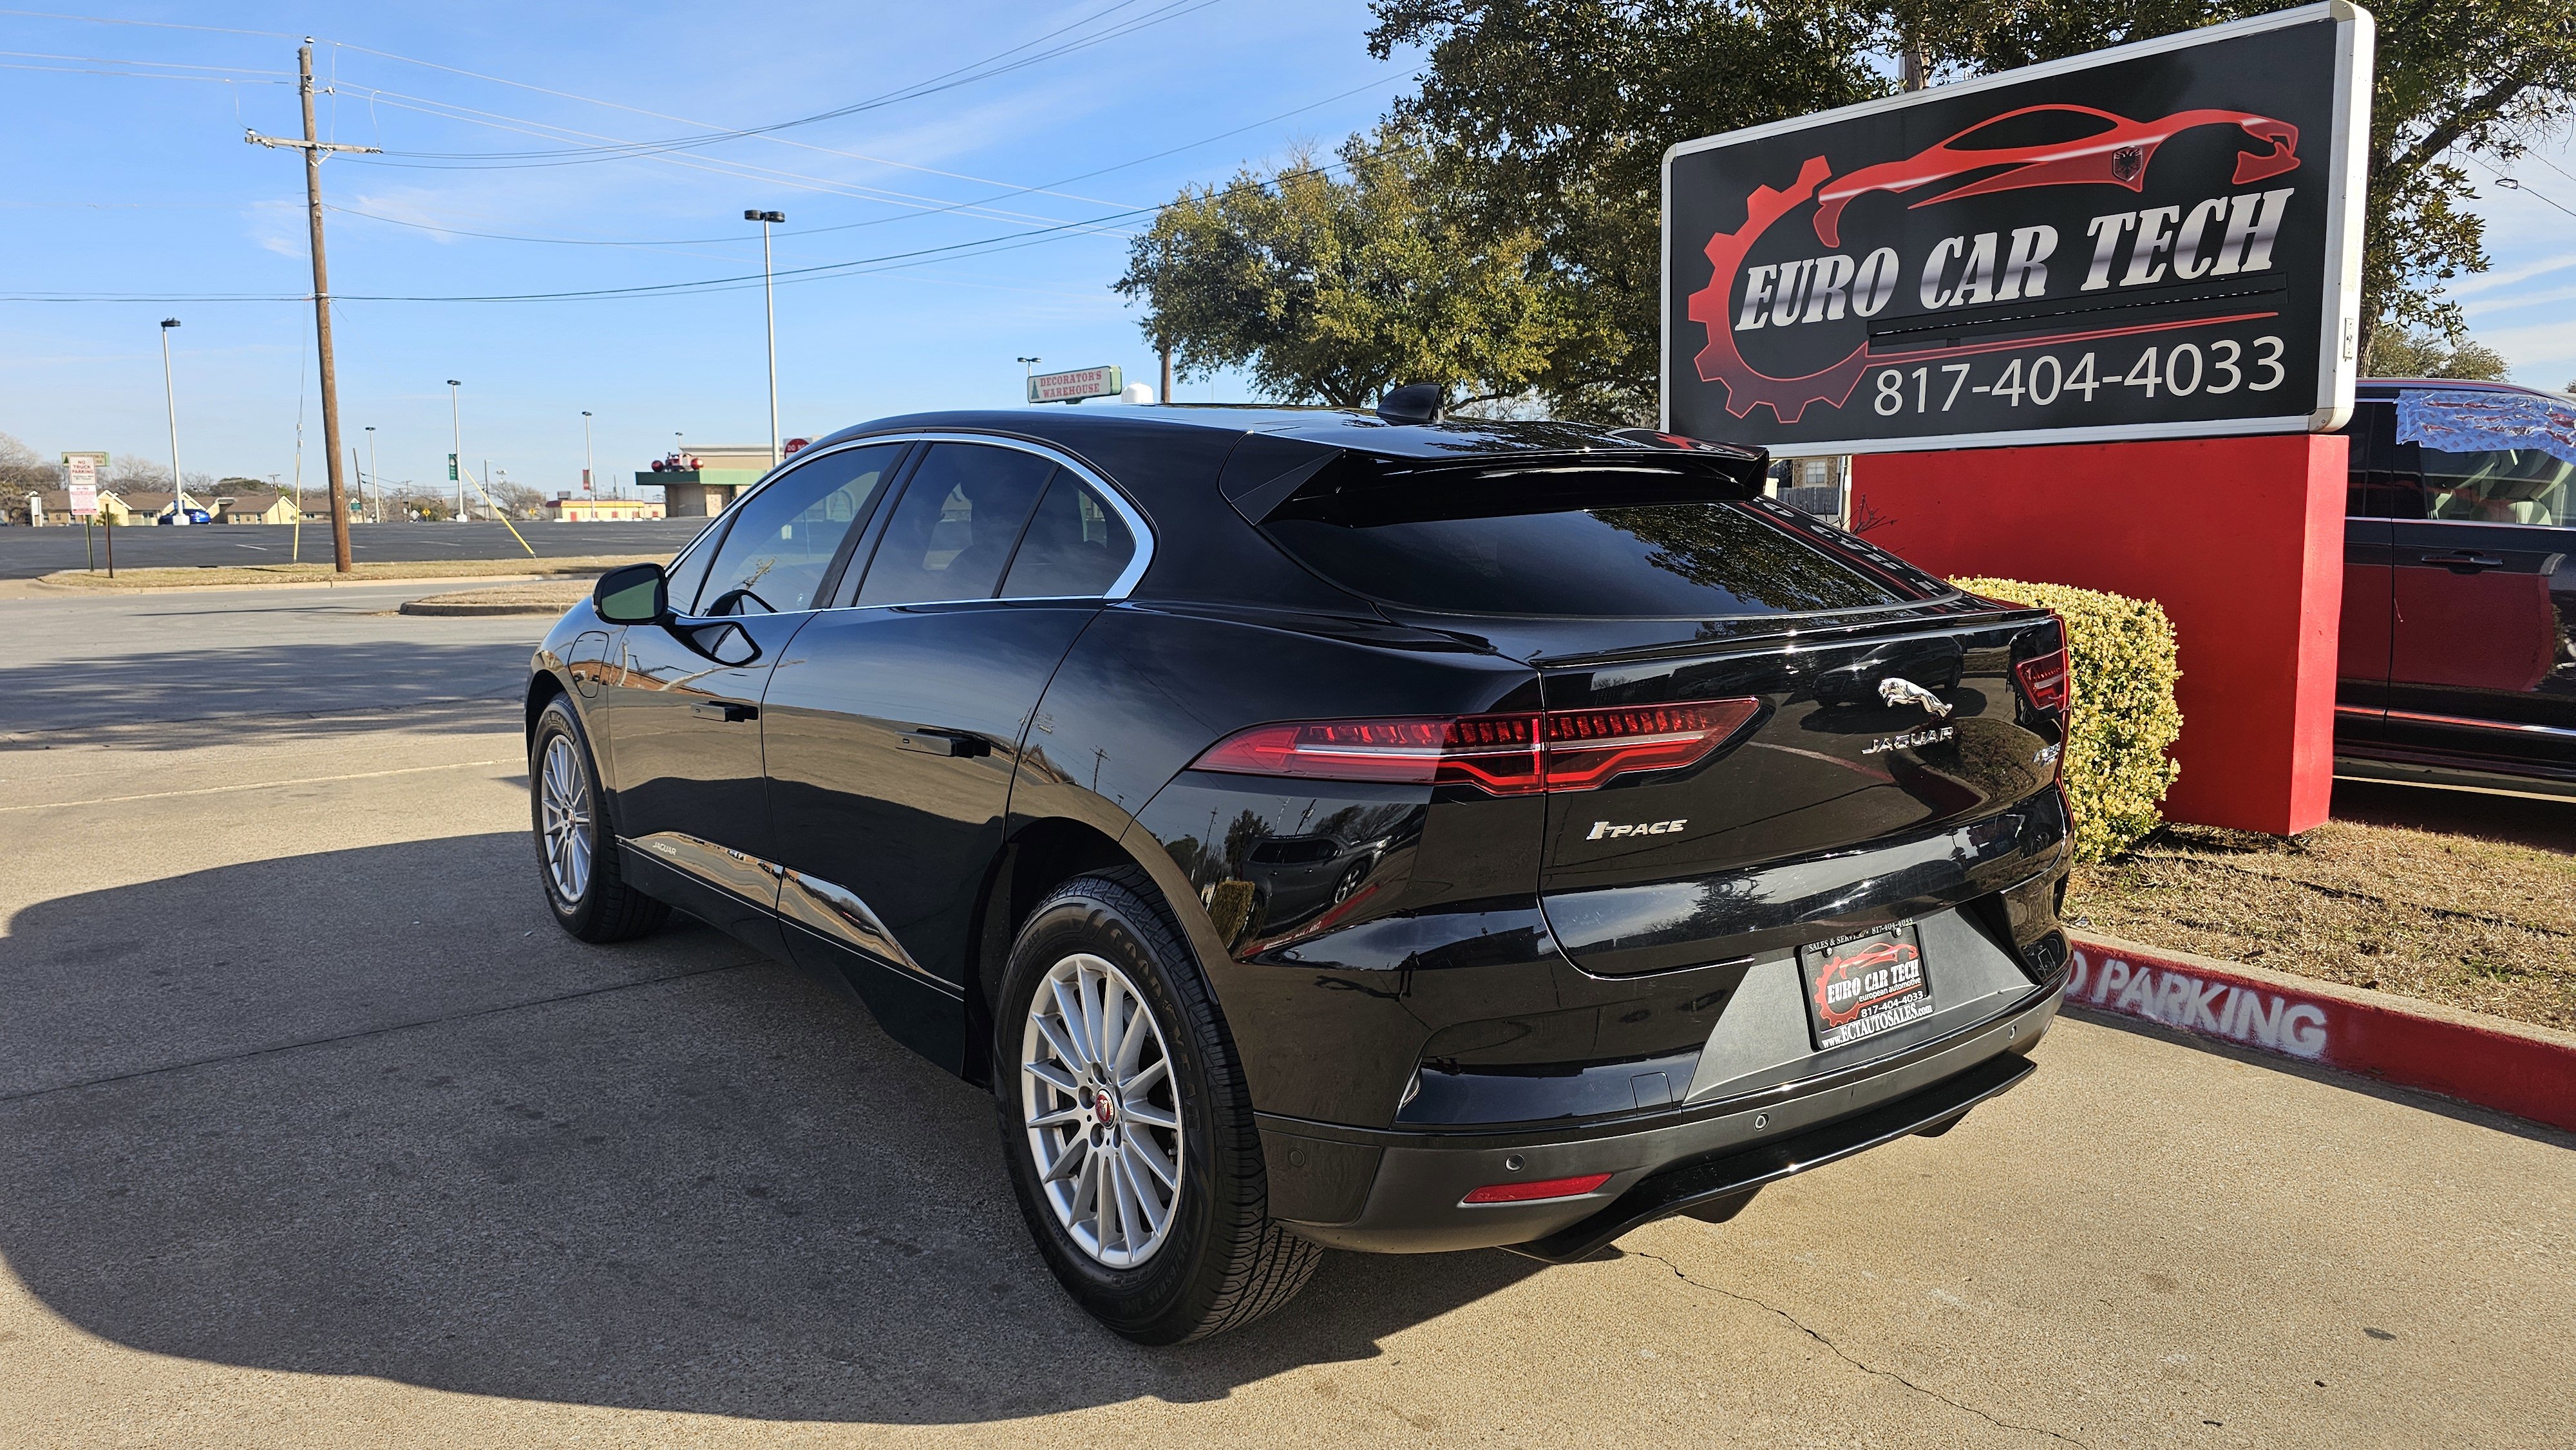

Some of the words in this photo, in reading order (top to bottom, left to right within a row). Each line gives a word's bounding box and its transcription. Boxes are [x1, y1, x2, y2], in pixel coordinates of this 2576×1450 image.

[1734, 247, 1899, 331] EURO
[1920, 225, 2059, 309] CAR
[2081, 187, 2295, 291] TECH
[1040, 370, 1102, 387] DECORATOR'S
[1873, 335, 2286, 416] 817-404-4033
[1043, 382, 1100, 399] WAREHOUSE
[1861, 726, 1954, 755] JAGUAR
[652, 841, 677, 856] JAGUAR
[1808, 939, 1829, 952] SALES
[1830, 937, 1836, 946] &
[1826, 977, 1861, 1004] EURO
[1864, 969, 1889, 992] CAR
[1890, 959, 1920, 984] TECH
[1859, 988, 1889, 1002] european
[1888, 977, 1922, 993] automotive
[1861, 990, 1924, 1018] 817-404-4033
[2065, 950, 2087, 997] O
[2092, 958, 2327, 1059] PARKING
[1108, 927, 1203, 1132] GOODYEAR
[1821, 1002, 1933, 1049] www.ECTAUTOSALES.com
